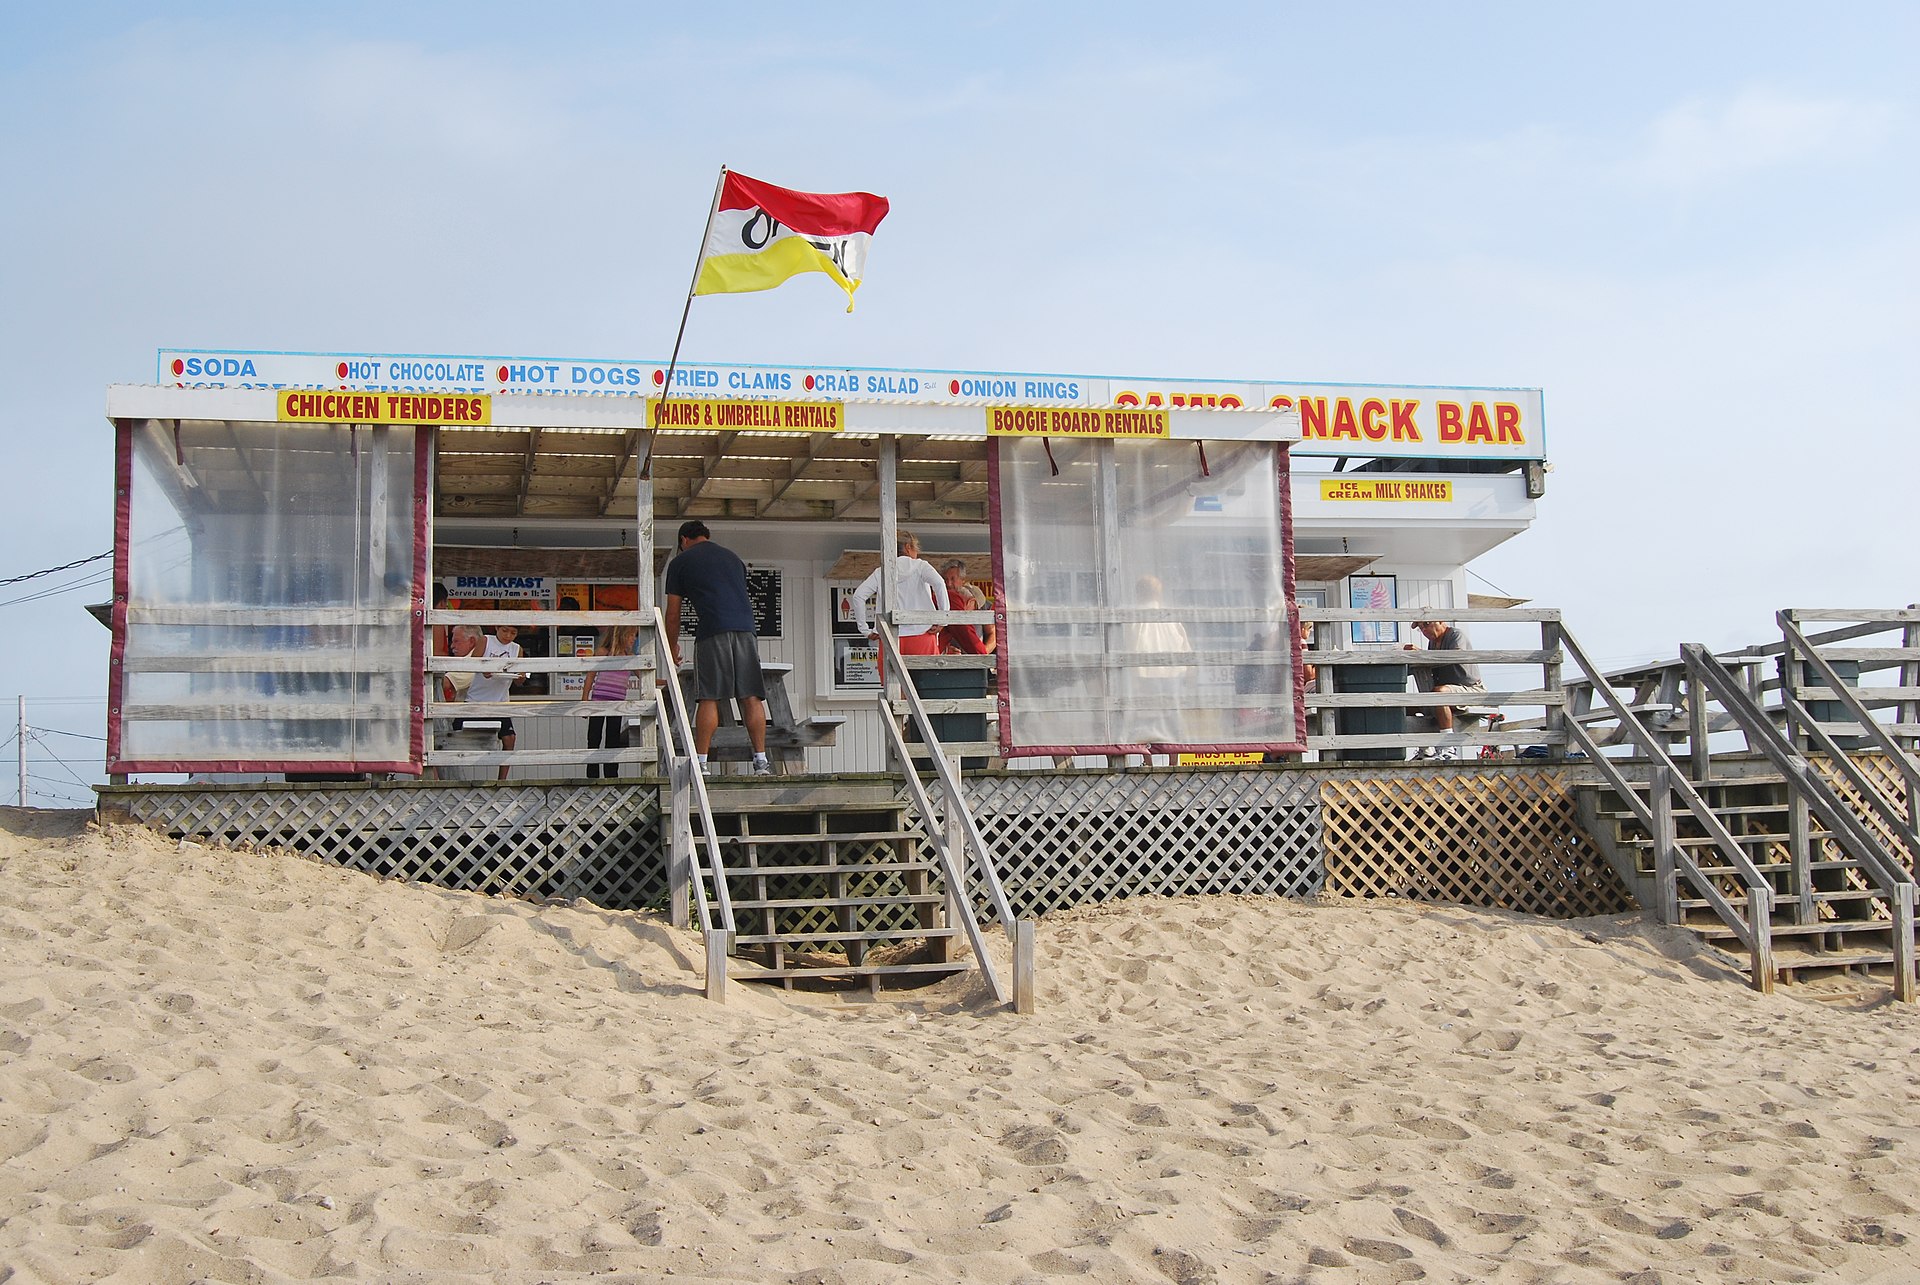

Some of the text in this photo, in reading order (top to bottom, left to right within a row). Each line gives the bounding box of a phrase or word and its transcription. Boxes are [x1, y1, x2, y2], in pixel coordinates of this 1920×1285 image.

[186, 358, 257, 377] SODA
[349, 362, 484, 382] HOT CHOCOLATE
[510, 365, 641, 386] HOT DOGS
[664, 369, 792, 391] FRIED CLAMS
[815, 374, 919, 394] CRAB SALAD
[961, 378, 1079, 400] ONION RINGS
[286, 393, 483, 421] CHICKEN TENDERS
[704, 406, 713, 426] &
[717, 404, 781, 427] UMBRELLA
[785, 406, 837, 429] RENTALS
[994, 410, 1163, 435] BOOGIE BOARD RENTALS
[1436, 400, 1526, 445] BAR
[1328, 491, 1372, 499] CREAM
[1340, 482, 1358, 490] ICE
[1375, 483, 1447, 499] MILK SHAKES
[457, 576, 543, 588] BREAKFAST
[448, 589, 477, 597] Served
[482, 589, 503, 598] Daily
[504, 589, 521, 597] 7am
[850, 651, 867, 660] MILK
